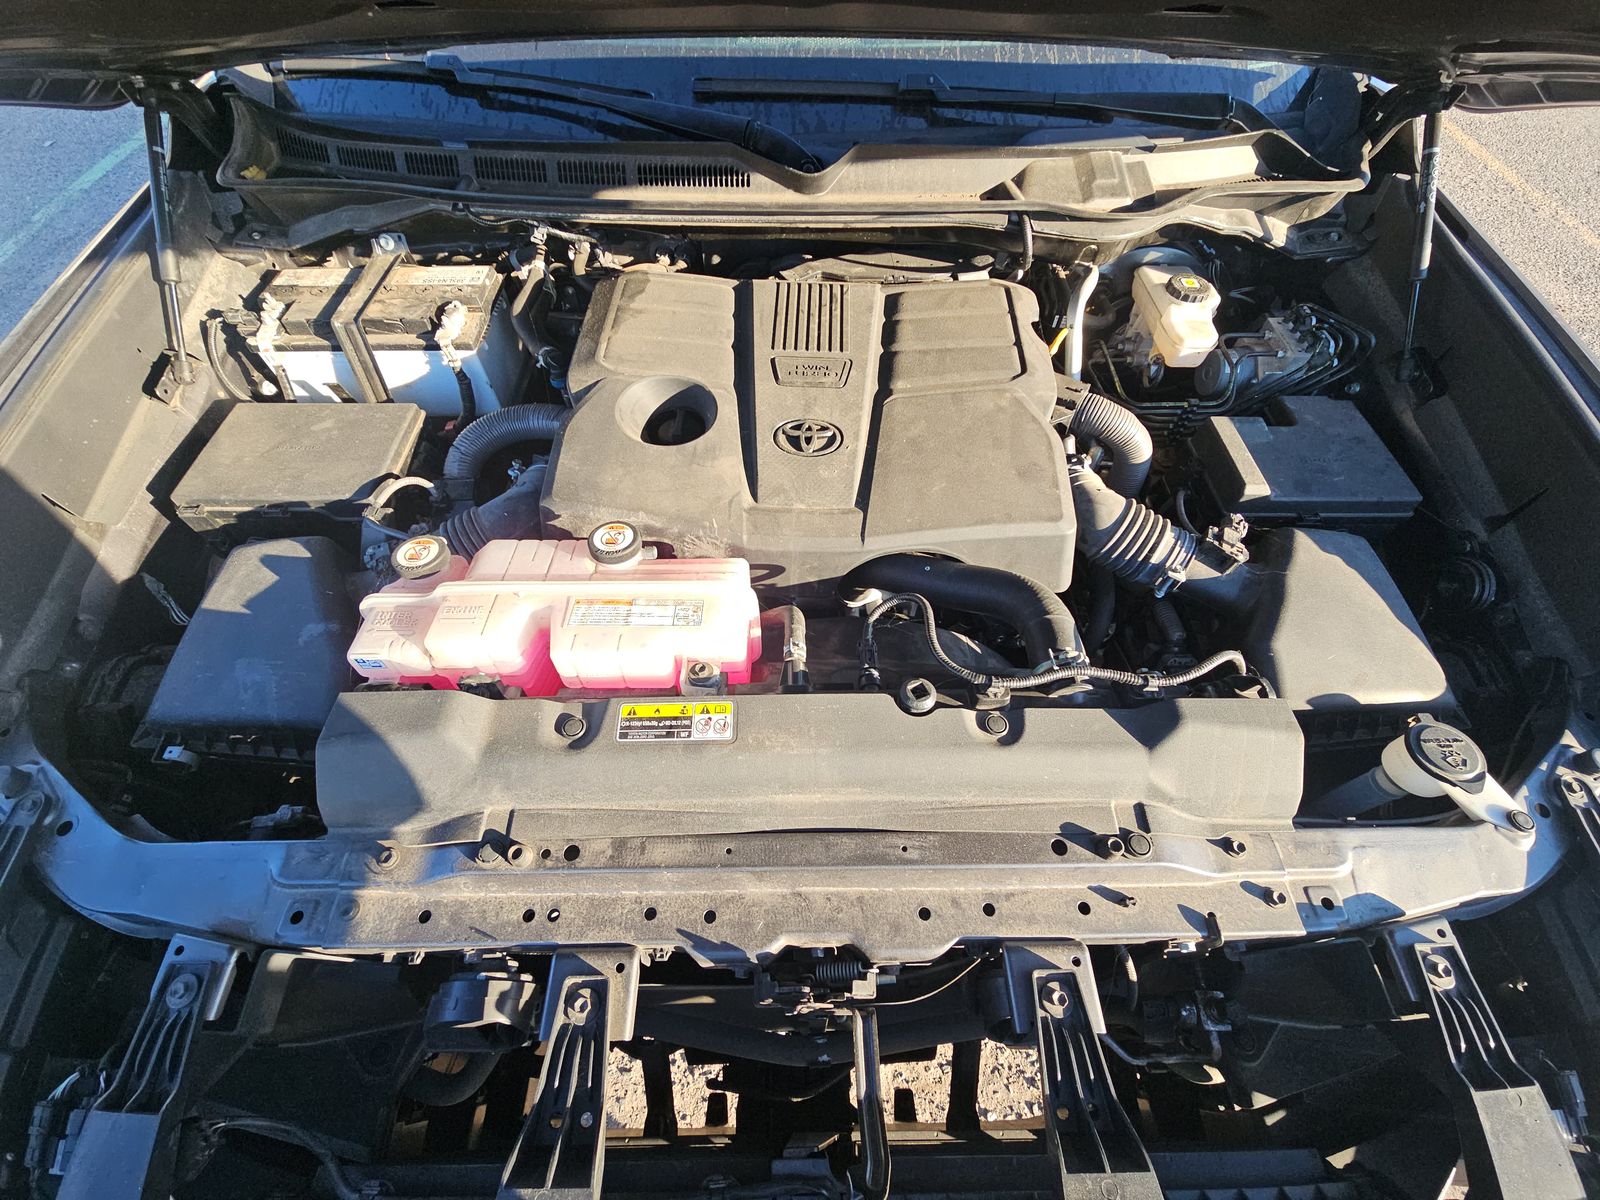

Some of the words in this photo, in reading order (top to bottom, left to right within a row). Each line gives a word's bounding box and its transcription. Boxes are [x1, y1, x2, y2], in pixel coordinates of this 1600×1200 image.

[786, 370, 839, 378] TURBO
[376, 610, 413, 618] INTER
[443, 606, 485, 614] ENGINE
